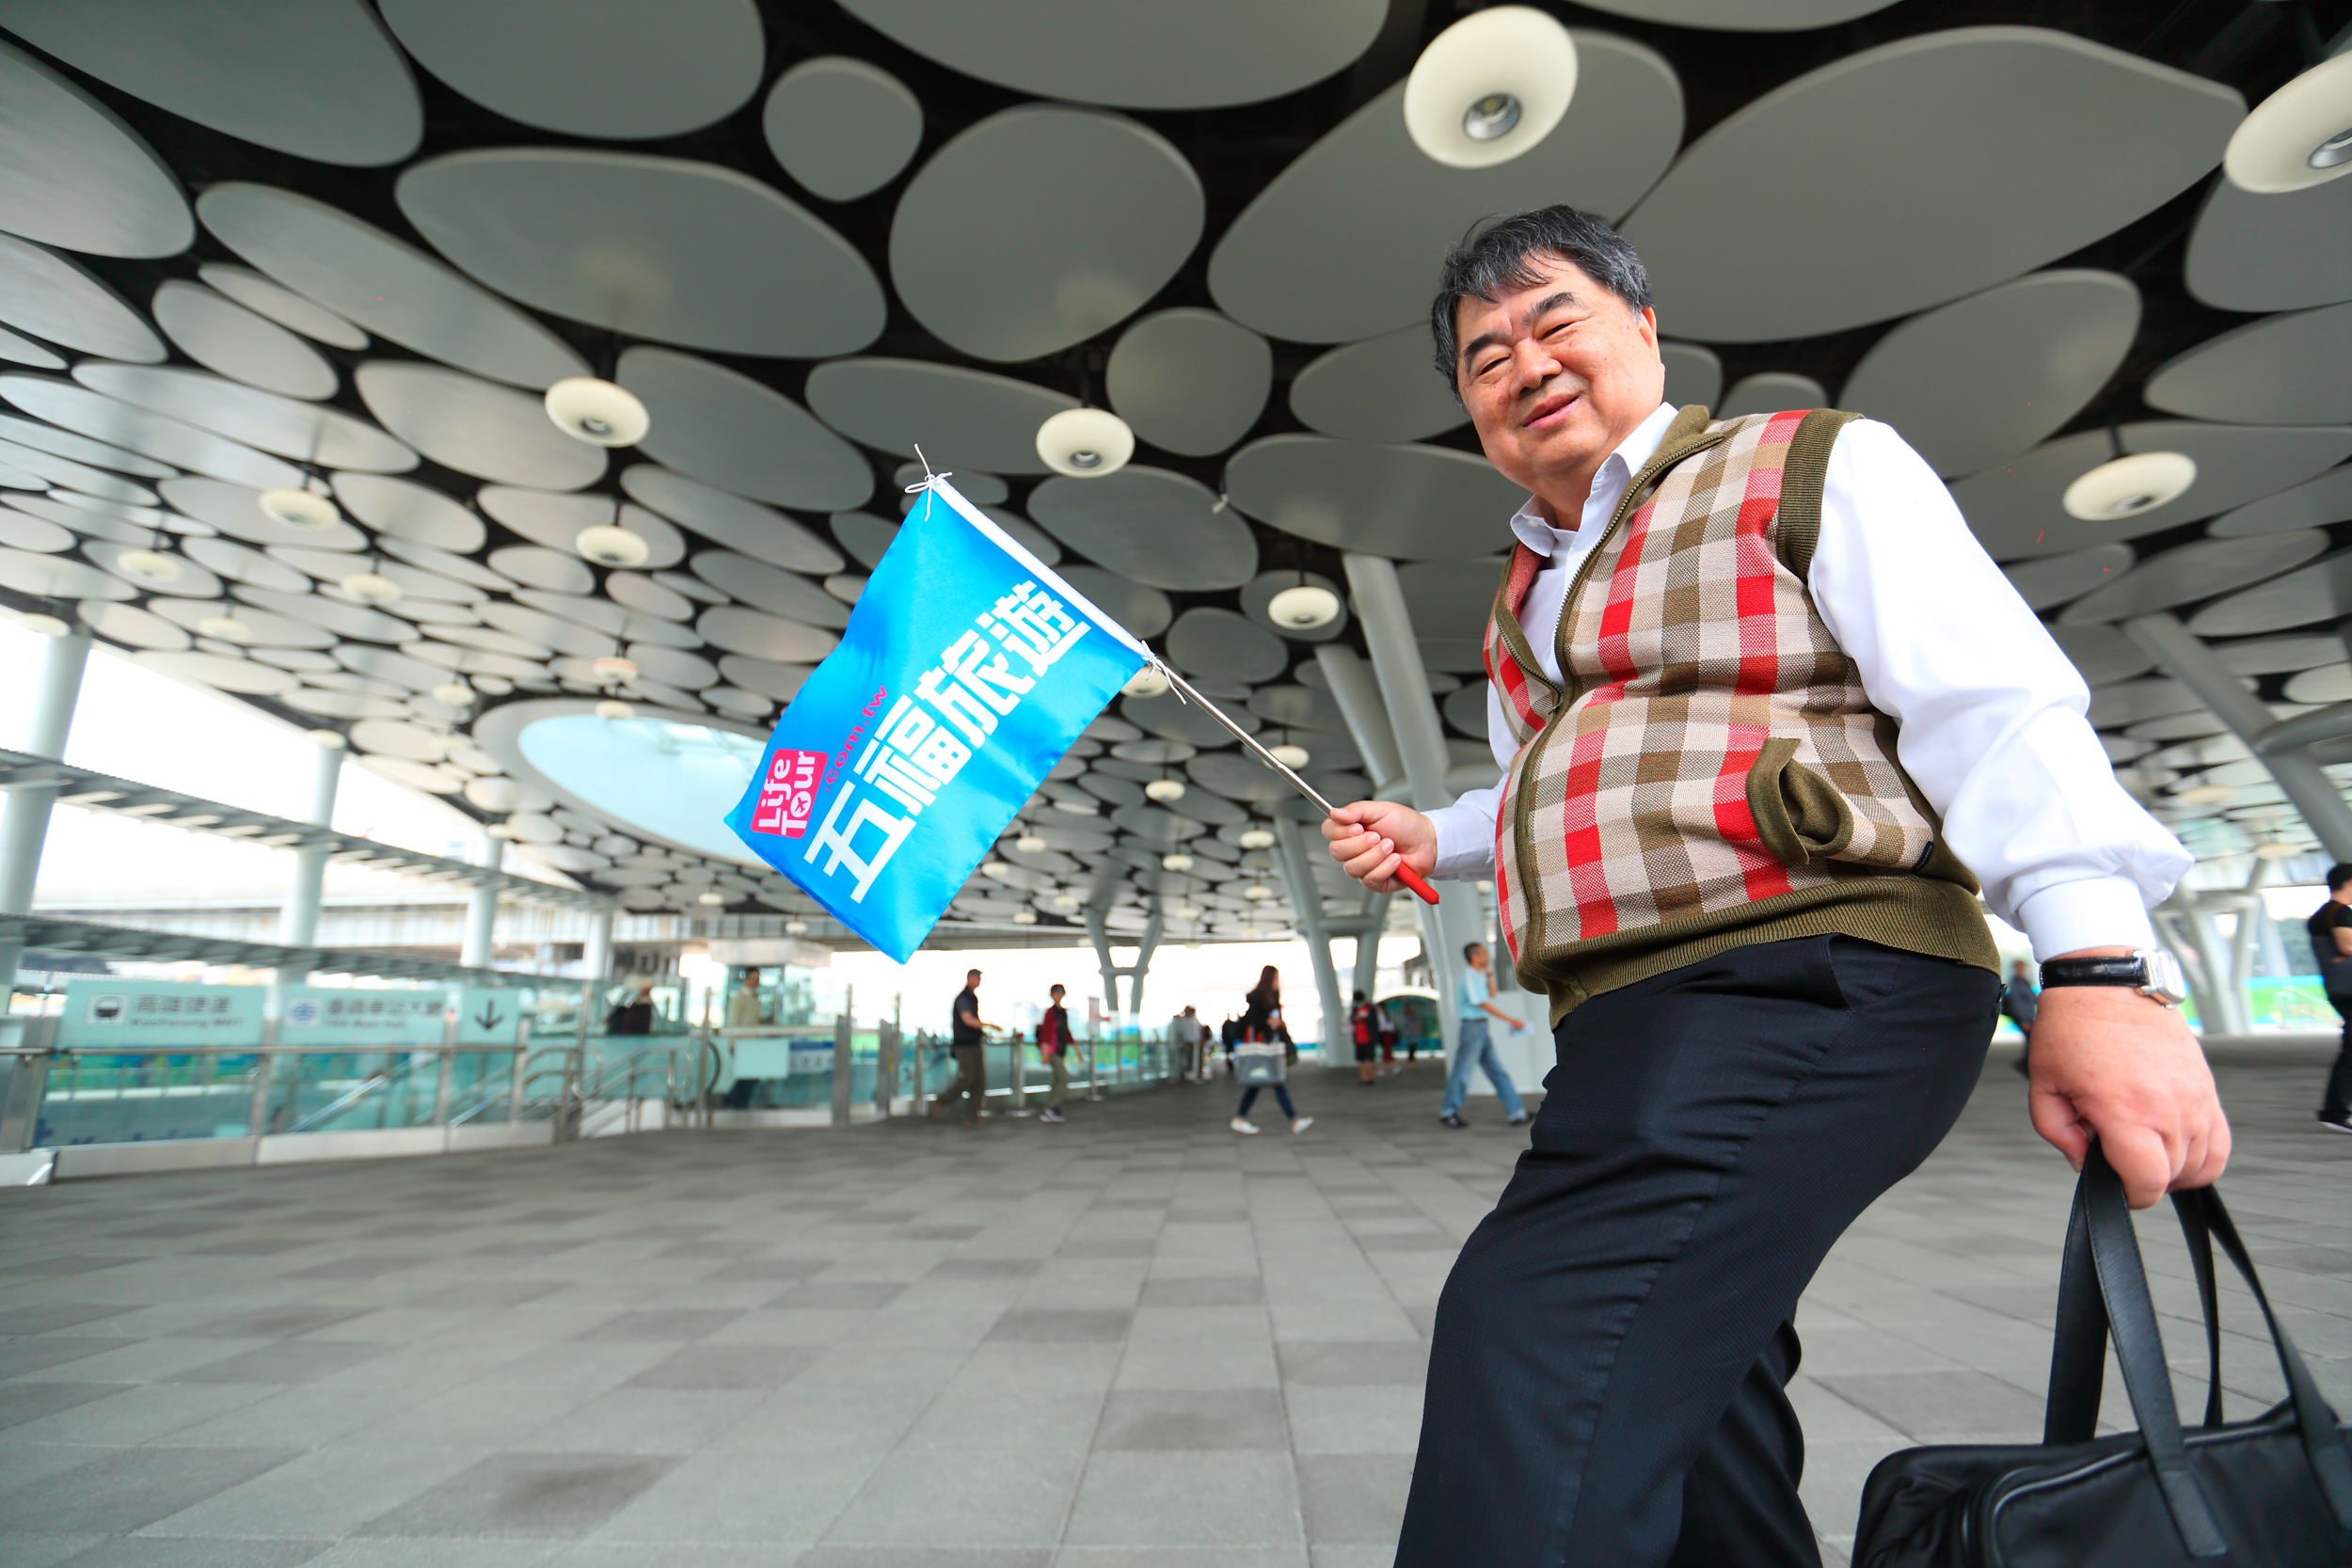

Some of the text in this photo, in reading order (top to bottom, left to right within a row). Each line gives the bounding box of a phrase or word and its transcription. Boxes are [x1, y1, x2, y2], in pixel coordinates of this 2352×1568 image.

[803, 580, 1091, 903] 五福旅遊
[826, 686, 887, 792] .com.tw
[758, 759, 792, 828] Life
[781, 751, 816, 835] Tour
